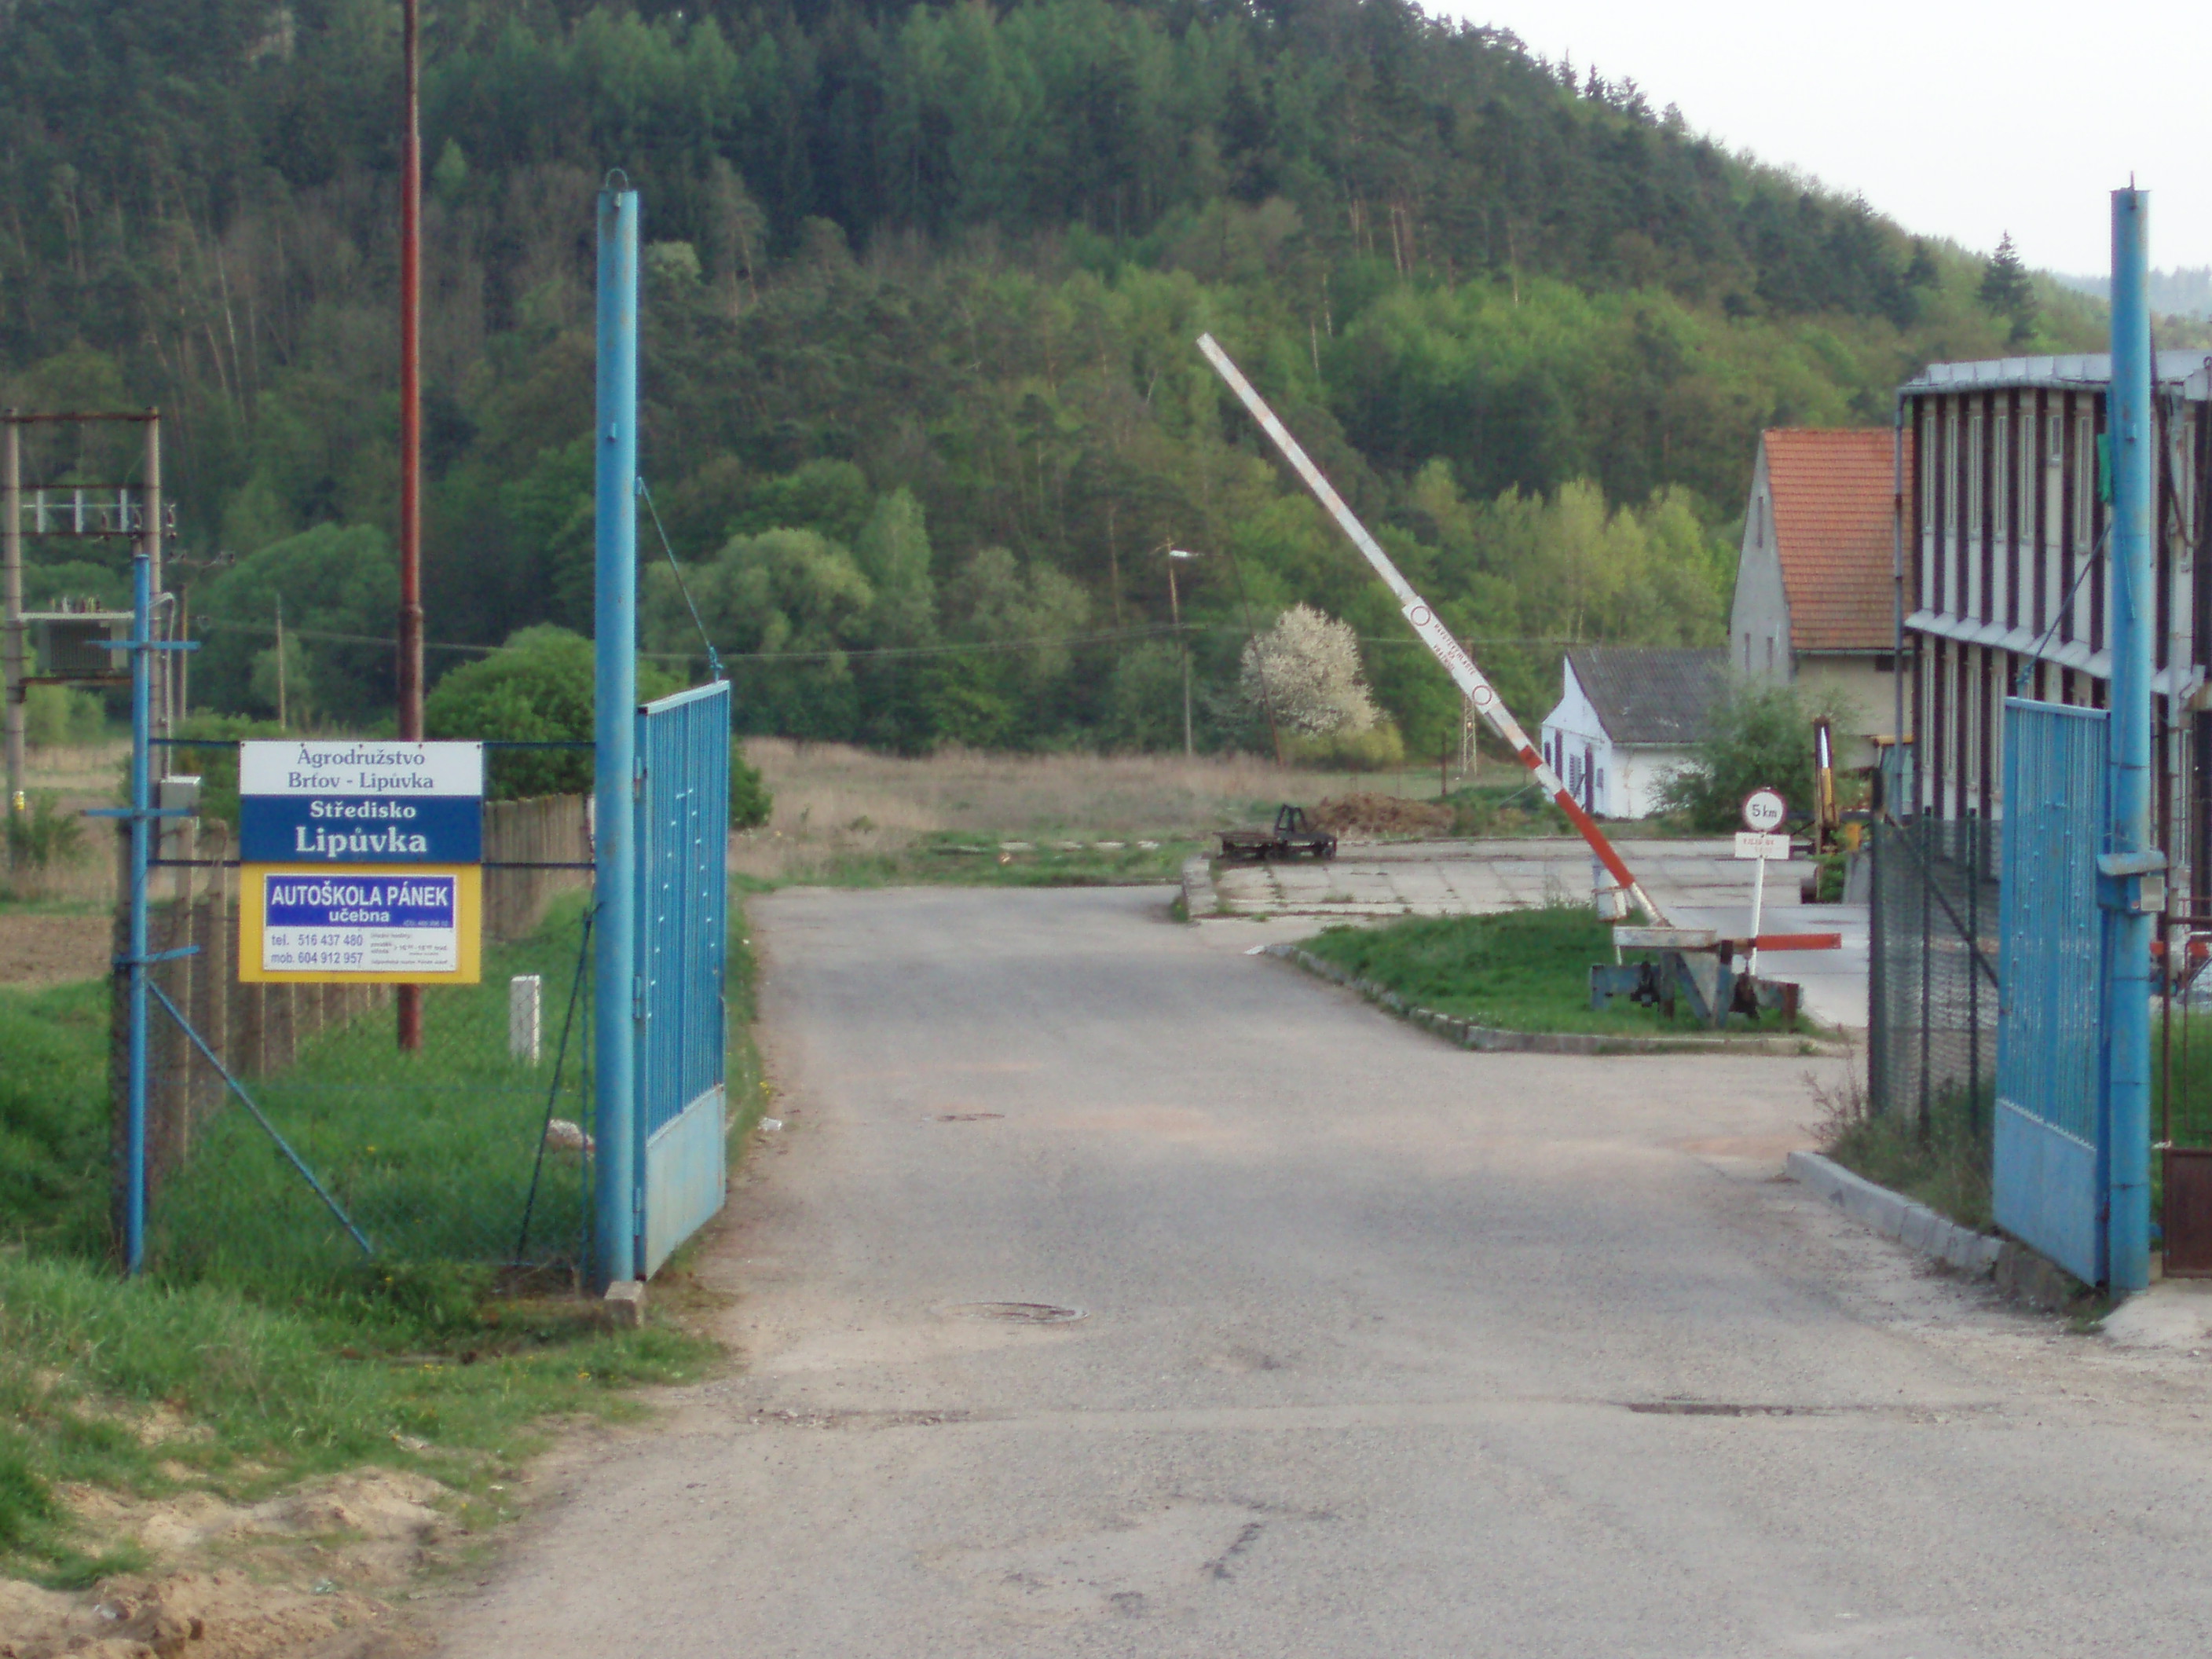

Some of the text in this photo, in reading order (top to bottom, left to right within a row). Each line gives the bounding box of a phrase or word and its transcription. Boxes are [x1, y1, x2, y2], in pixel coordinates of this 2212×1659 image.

[297, 748, 425, 767] Agrodružstvo
[359, 772, 434, 792] Lipůvka
[310, 801, 416, 818] Středisko
[1752, 804, 1777, 818] 5 km
[295, 826, 427, 858] Lipůvka
[272, 881, 449, 906] AUTOŠKOLA PÁNEK
[329, 910, 390, 922] učebna
[271, 935, 289, 946] tel.
[298, 935, 317, 946] 516
[320, 935, 340, 946] 437
[343, 934, 363, 947] 480
[271, 952, 294, 963] mob.
[298, 952, 317, 963] 604
[320, 952, 340, 963] 912
[343, 952, 363, 963] 957
